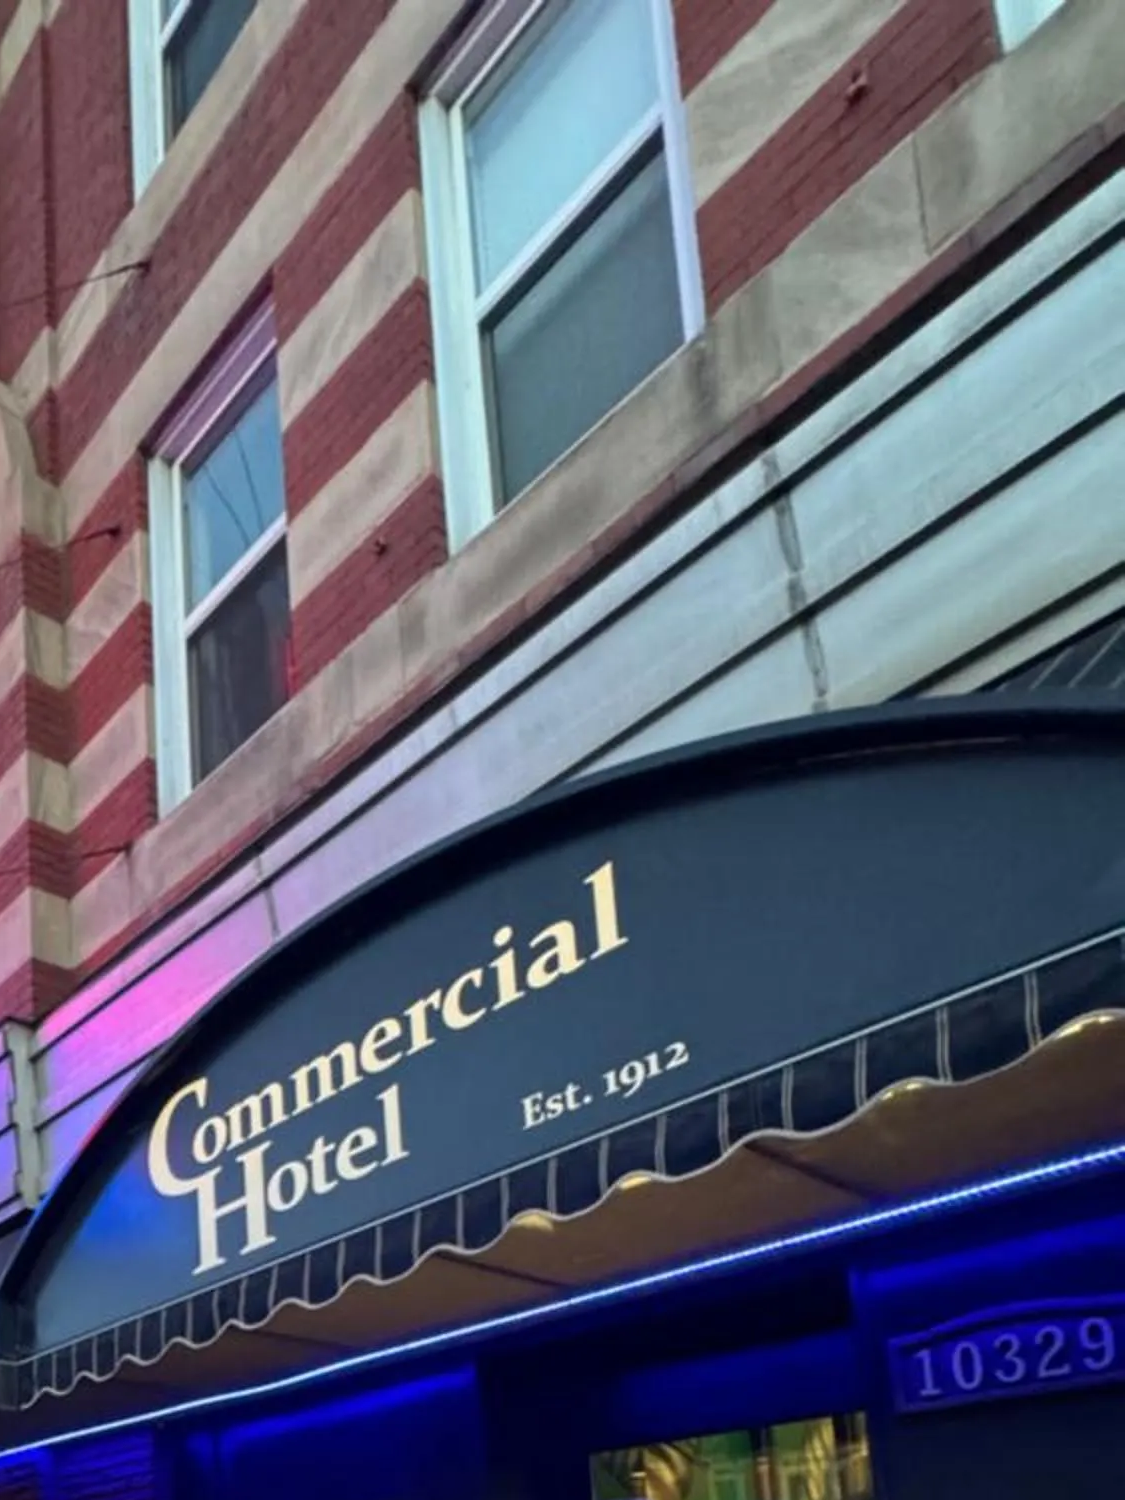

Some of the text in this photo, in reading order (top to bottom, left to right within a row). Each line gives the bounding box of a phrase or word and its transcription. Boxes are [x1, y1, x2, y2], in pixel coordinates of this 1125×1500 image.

[147, 860, 629, 1197] Commercial
[521, 1041, 690, 1130] Est. 1912
[192, 1084, 410, 1275] Hotel
[913, 1316, 1115, 1397] 10329
